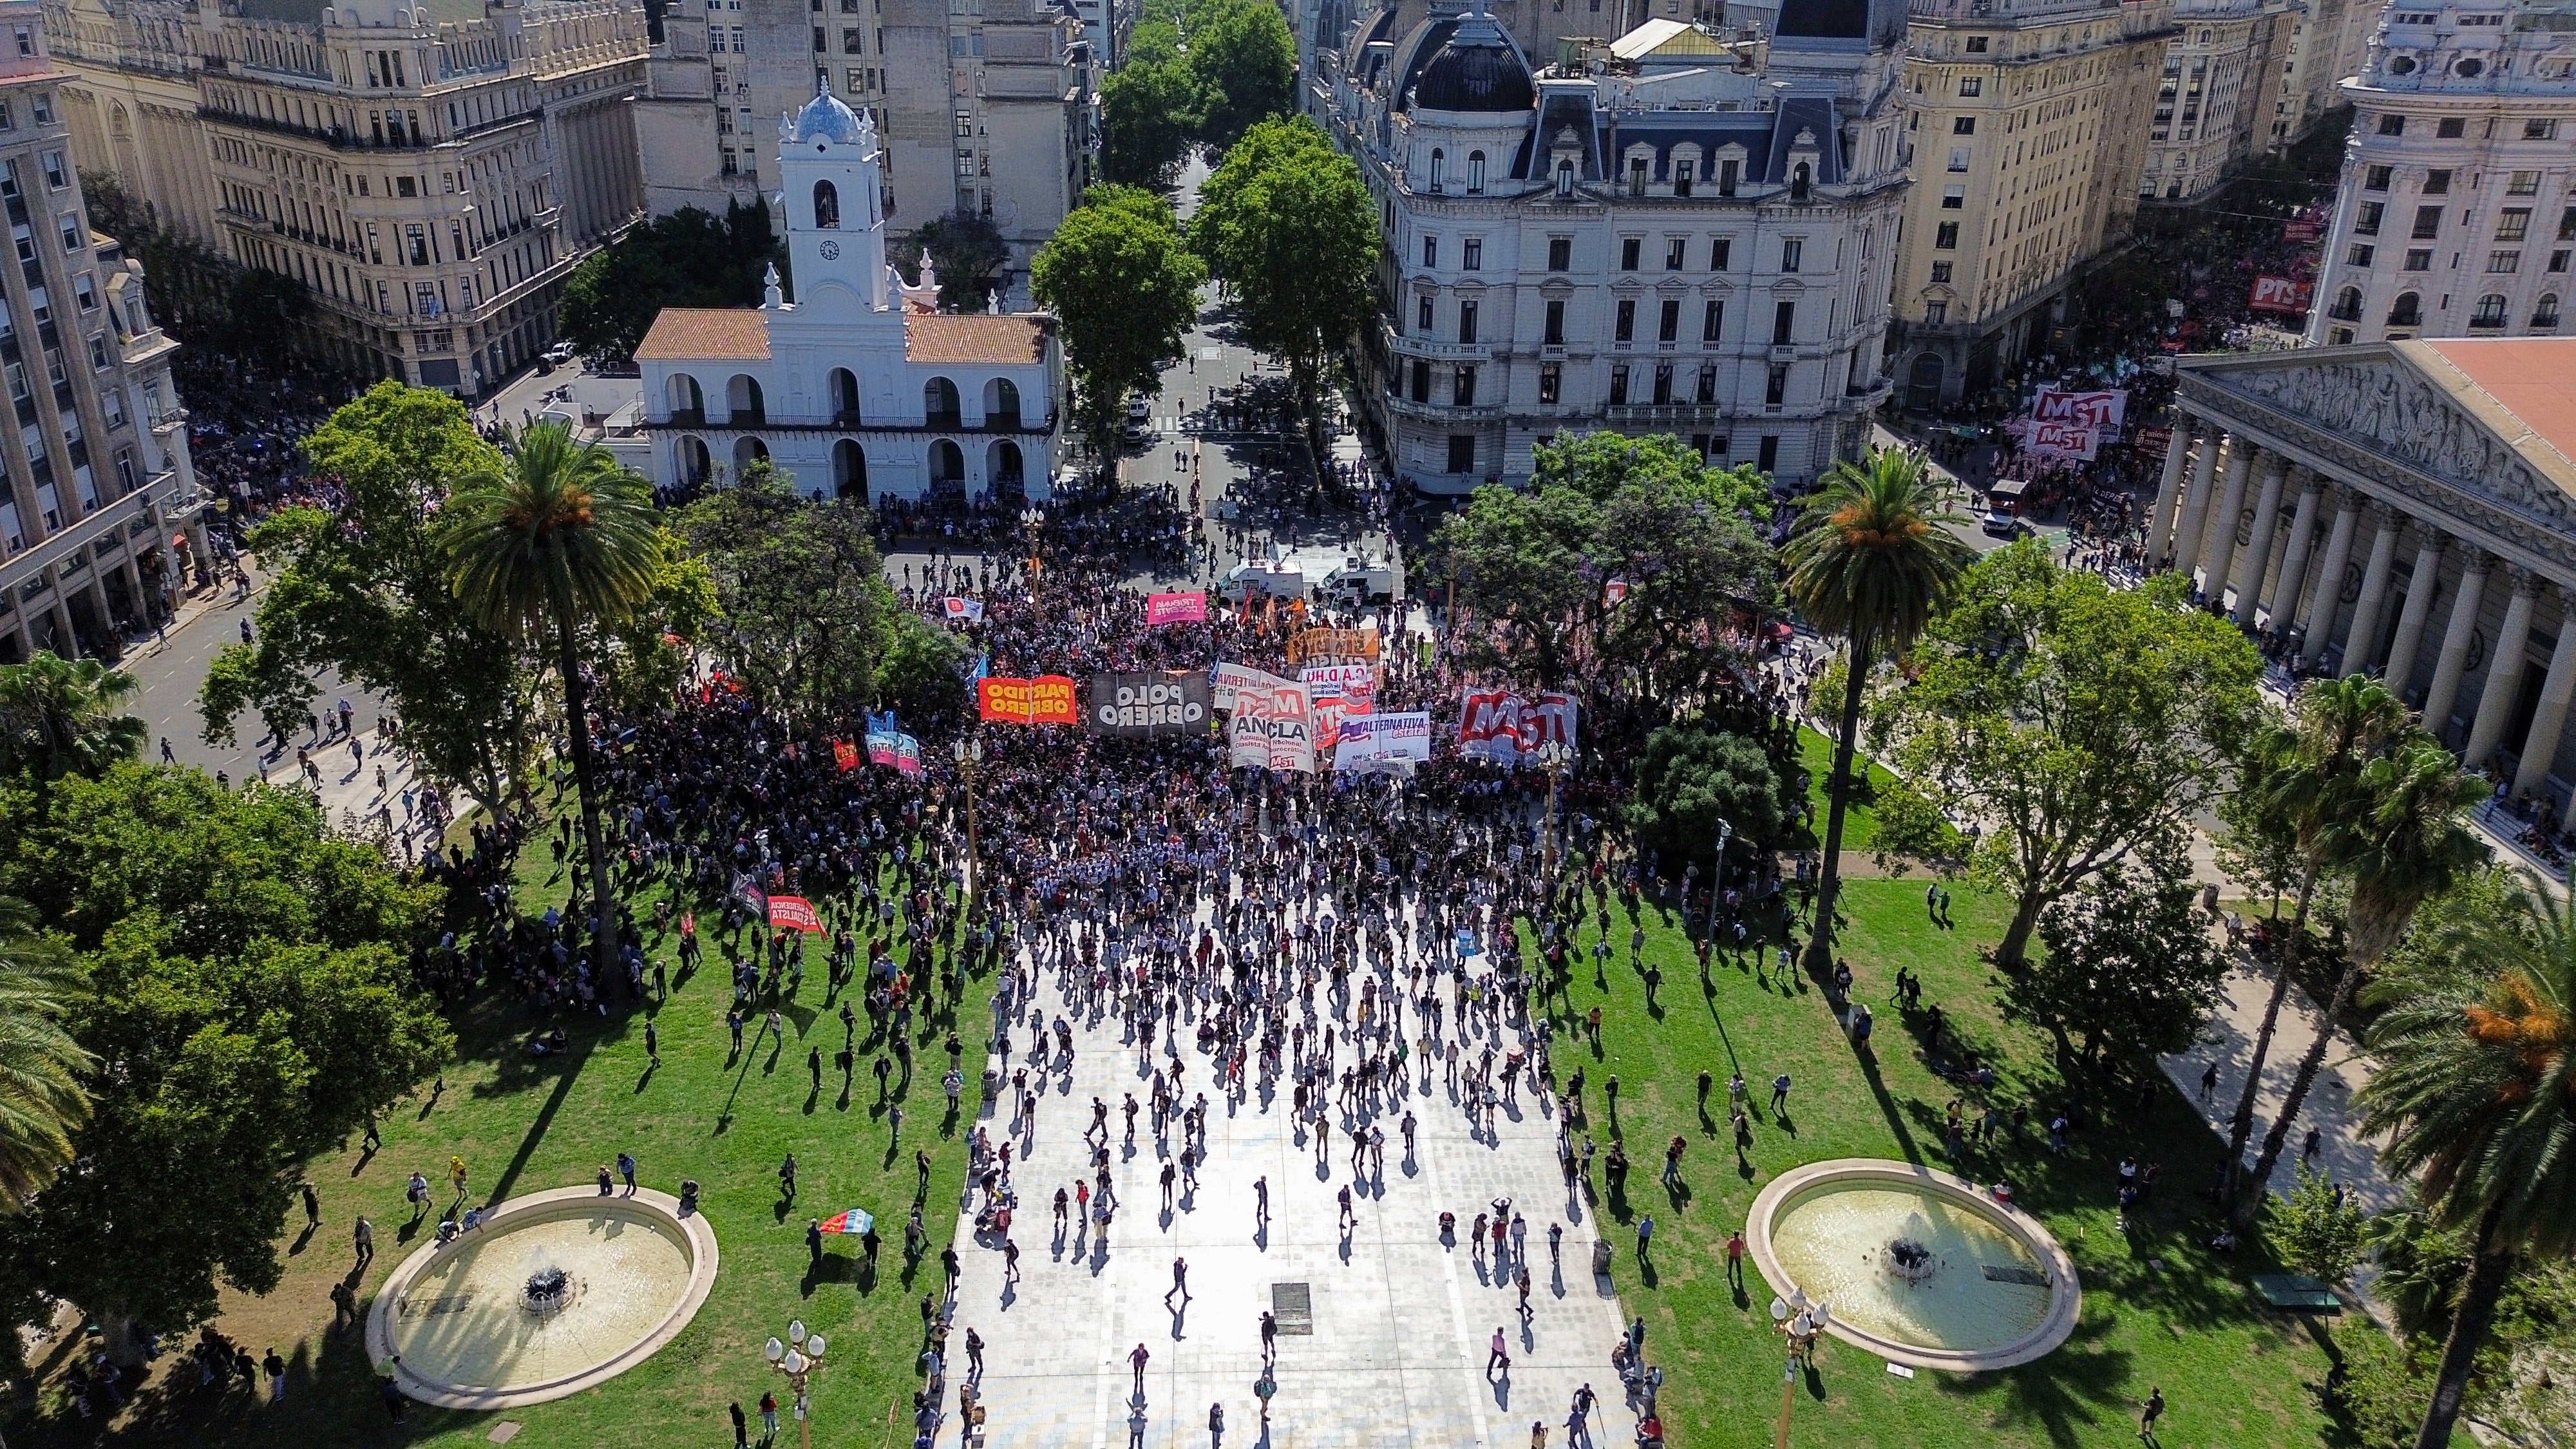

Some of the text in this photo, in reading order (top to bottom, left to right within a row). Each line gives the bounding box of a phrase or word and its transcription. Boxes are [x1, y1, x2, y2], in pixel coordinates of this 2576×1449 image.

[2255, 278, 2297, 305] PTS
[2037, 392, 2114, 428] MST
[2035, 425, 2088, 451] MST
[1235, 717, 1306, 741] ANCLA
[1361, 718, 1424, 734] ALTERNATIVA
[1392, 724, 1428, 739] estatal
[1464, 692, 1567, 750] MST
[1270, 755, 1295, 768] MST
